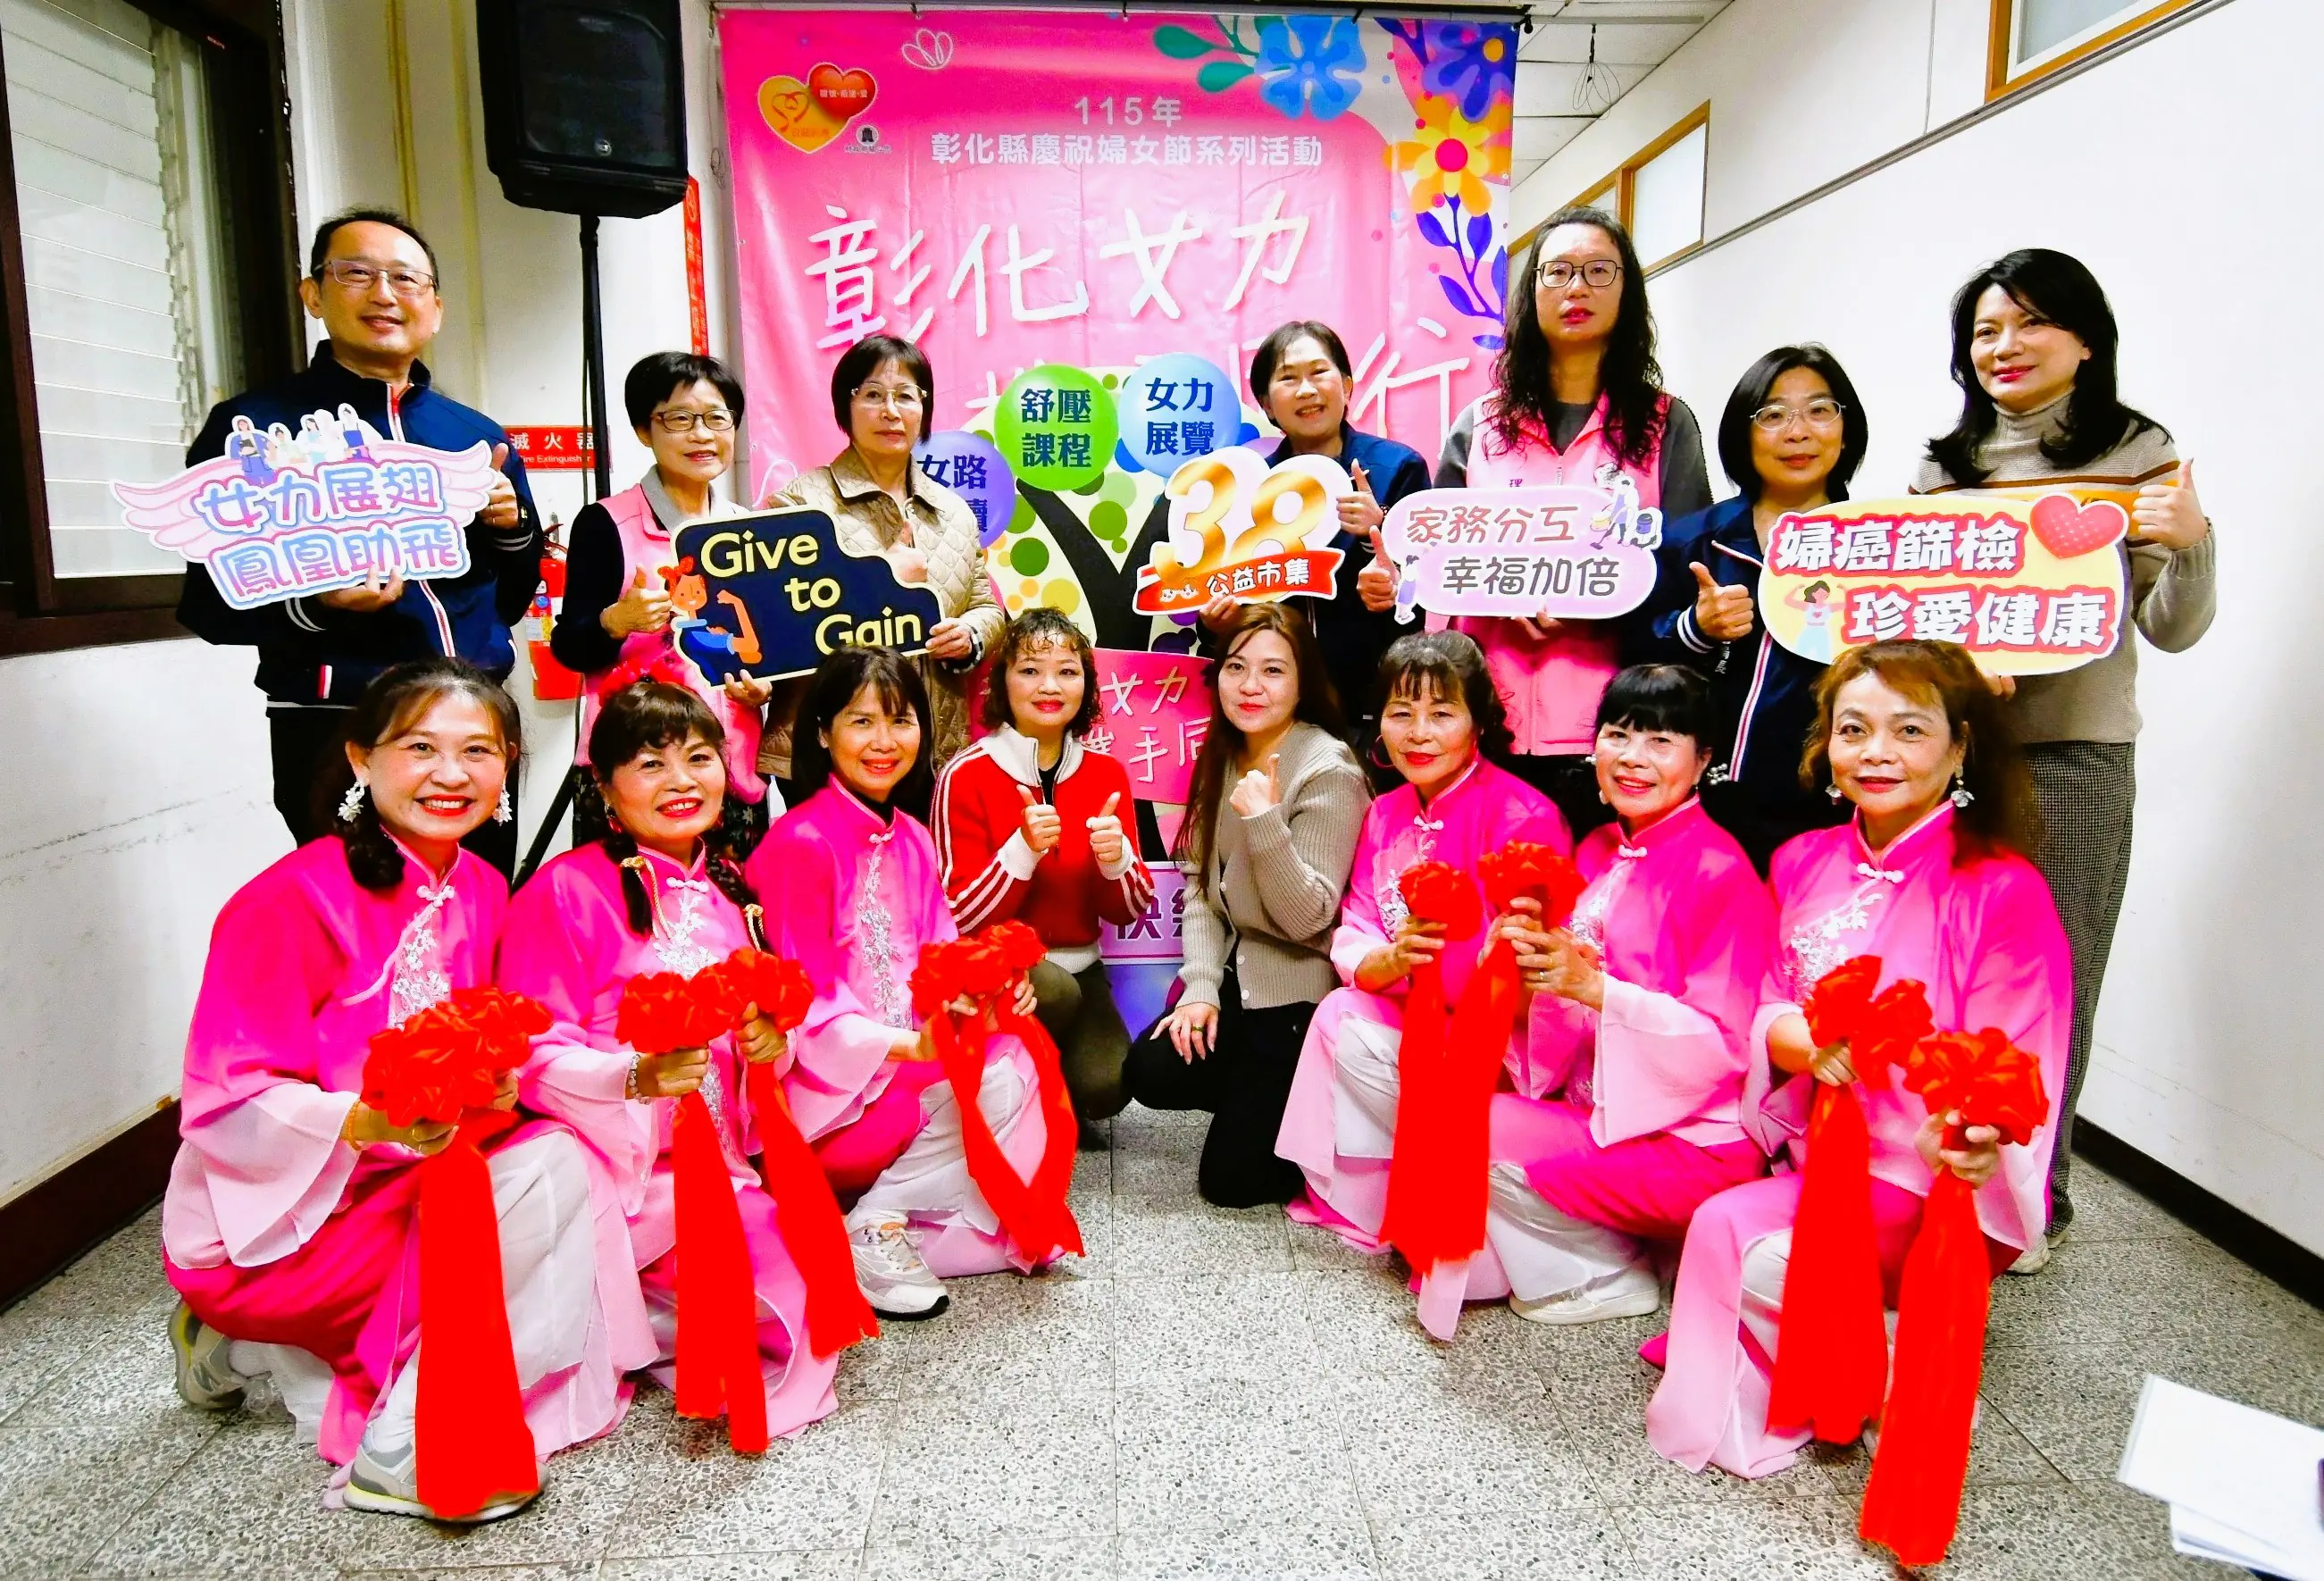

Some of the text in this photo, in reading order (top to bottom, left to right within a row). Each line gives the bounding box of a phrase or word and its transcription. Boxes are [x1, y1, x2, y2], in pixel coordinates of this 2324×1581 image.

[1074, 96, 1183, 128] 115年
[931, 132, 1323, 166] 彰化縣慶祝婦女節系列活動
[805, 190, 1310, 349] 彰化女力
[1020, 388, 1092, 423] 舒壓
[1144, 376, 1215, 413] 女力
[520, 454, 592, 464] ire Extinguishr
[1021, 431, 1092, 469] 課程
[1145, 421, 1215, 456] 展覽
[202, 464, 440, 528] 女力展翅
[1153, 460, 1327, 602] 38
[1407, 506, 1579, 544] 家務分工
[1775, 518, 2020, 572] 婦癌篩檢
[221, 522, 458, 599] 鳳凰助飛
[700, 530, 818, 578] Give
[784, 577, 841, 612] to
[1204, 557, 1311, 598] 公益市集
[1442, 556, 1620, 597] 幸福加倍
[815, 606, 923, 657] Gain
[1848, 590, 2107, 648] 珍愛健康
[1099, 665, 1188, 716] 女力
